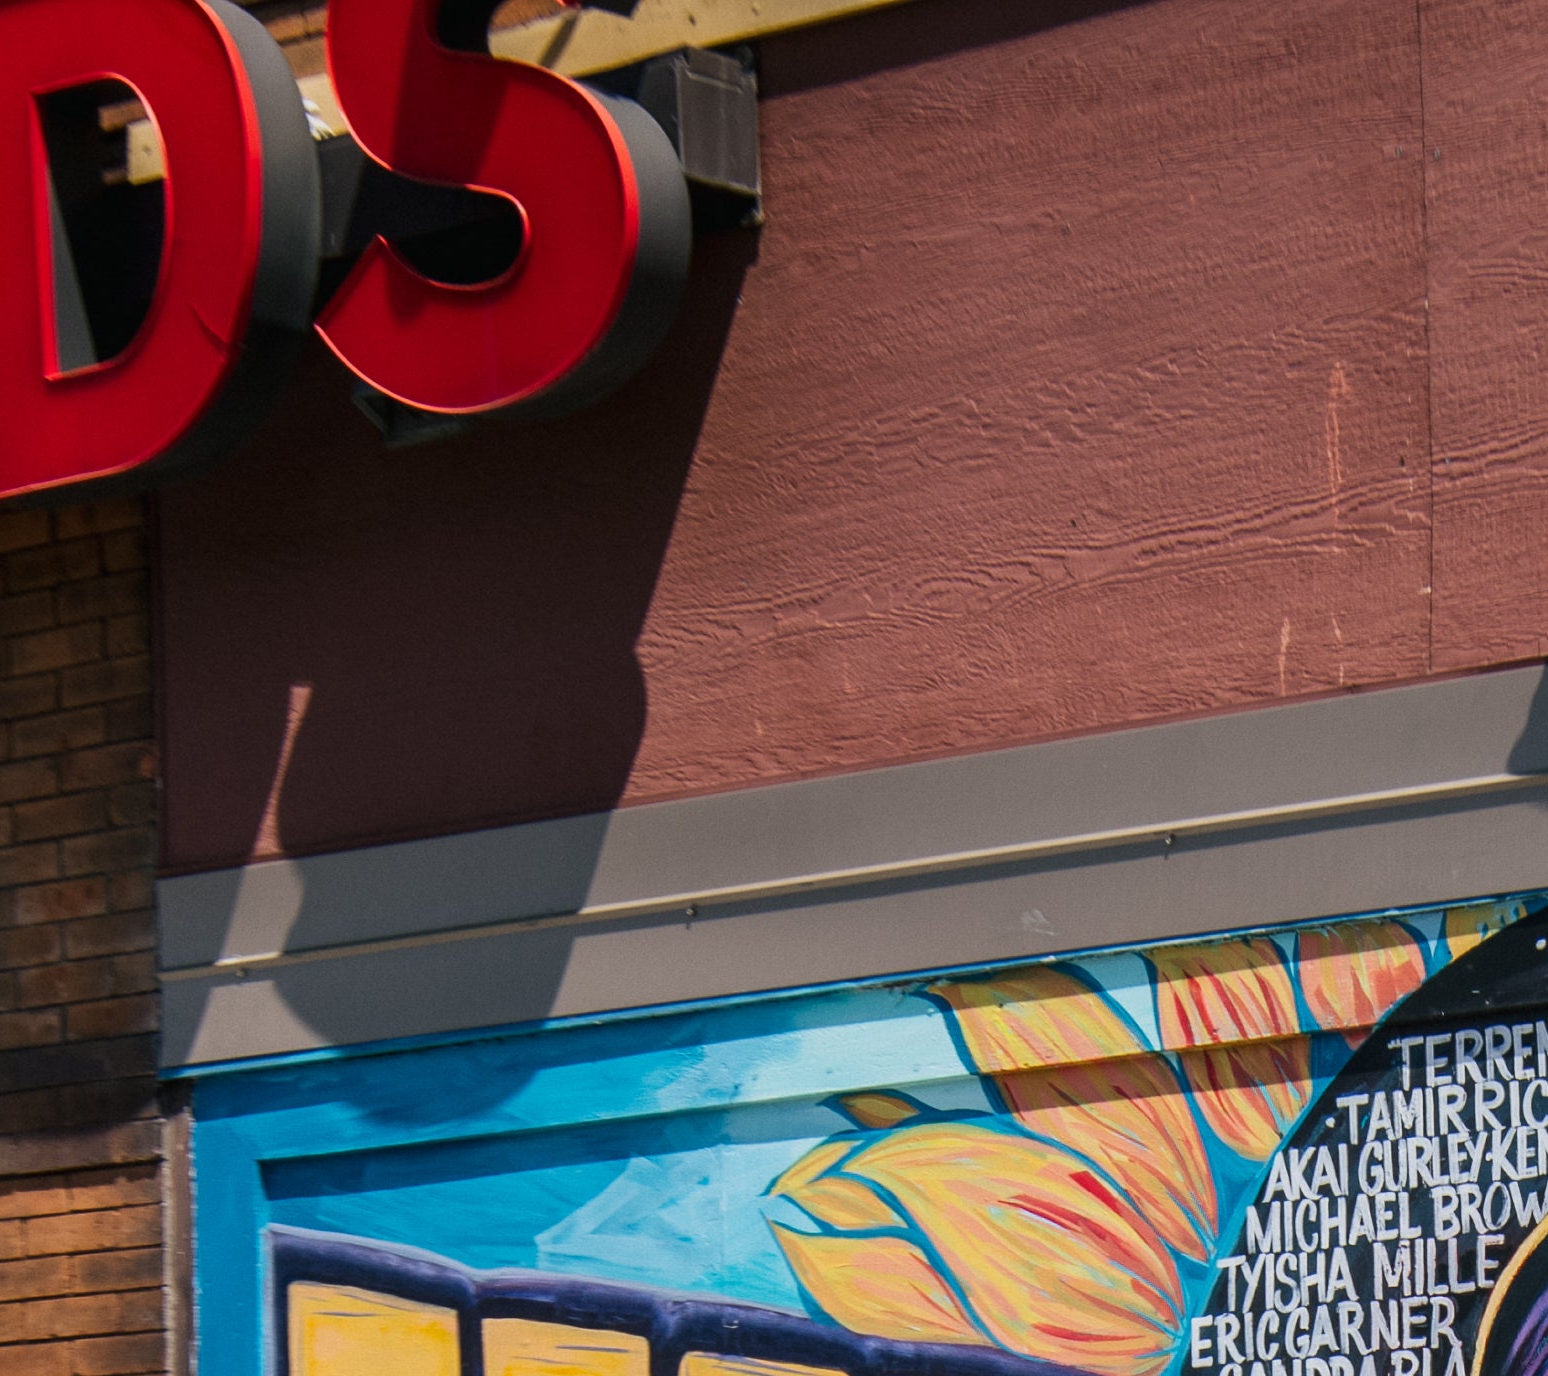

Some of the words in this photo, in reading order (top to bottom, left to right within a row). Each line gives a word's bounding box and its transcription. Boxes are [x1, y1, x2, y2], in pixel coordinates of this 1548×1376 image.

[1337, 1086, 1472, 1146] TAMIR
[1262, 1143, 1349, 1204] AKAI
[1358, 1130, 1488, 1197] GURLEY
[1245, 1190, 1423, 1255] MICHAEL
[1216, 1246, 1357, 1315] TYISHA
[1372, 1233, 1506, 1301] MILLE
[1191, 1311, 1280, 1369] ERIC
[1284, 1295, 1464, 1361] GARNER
